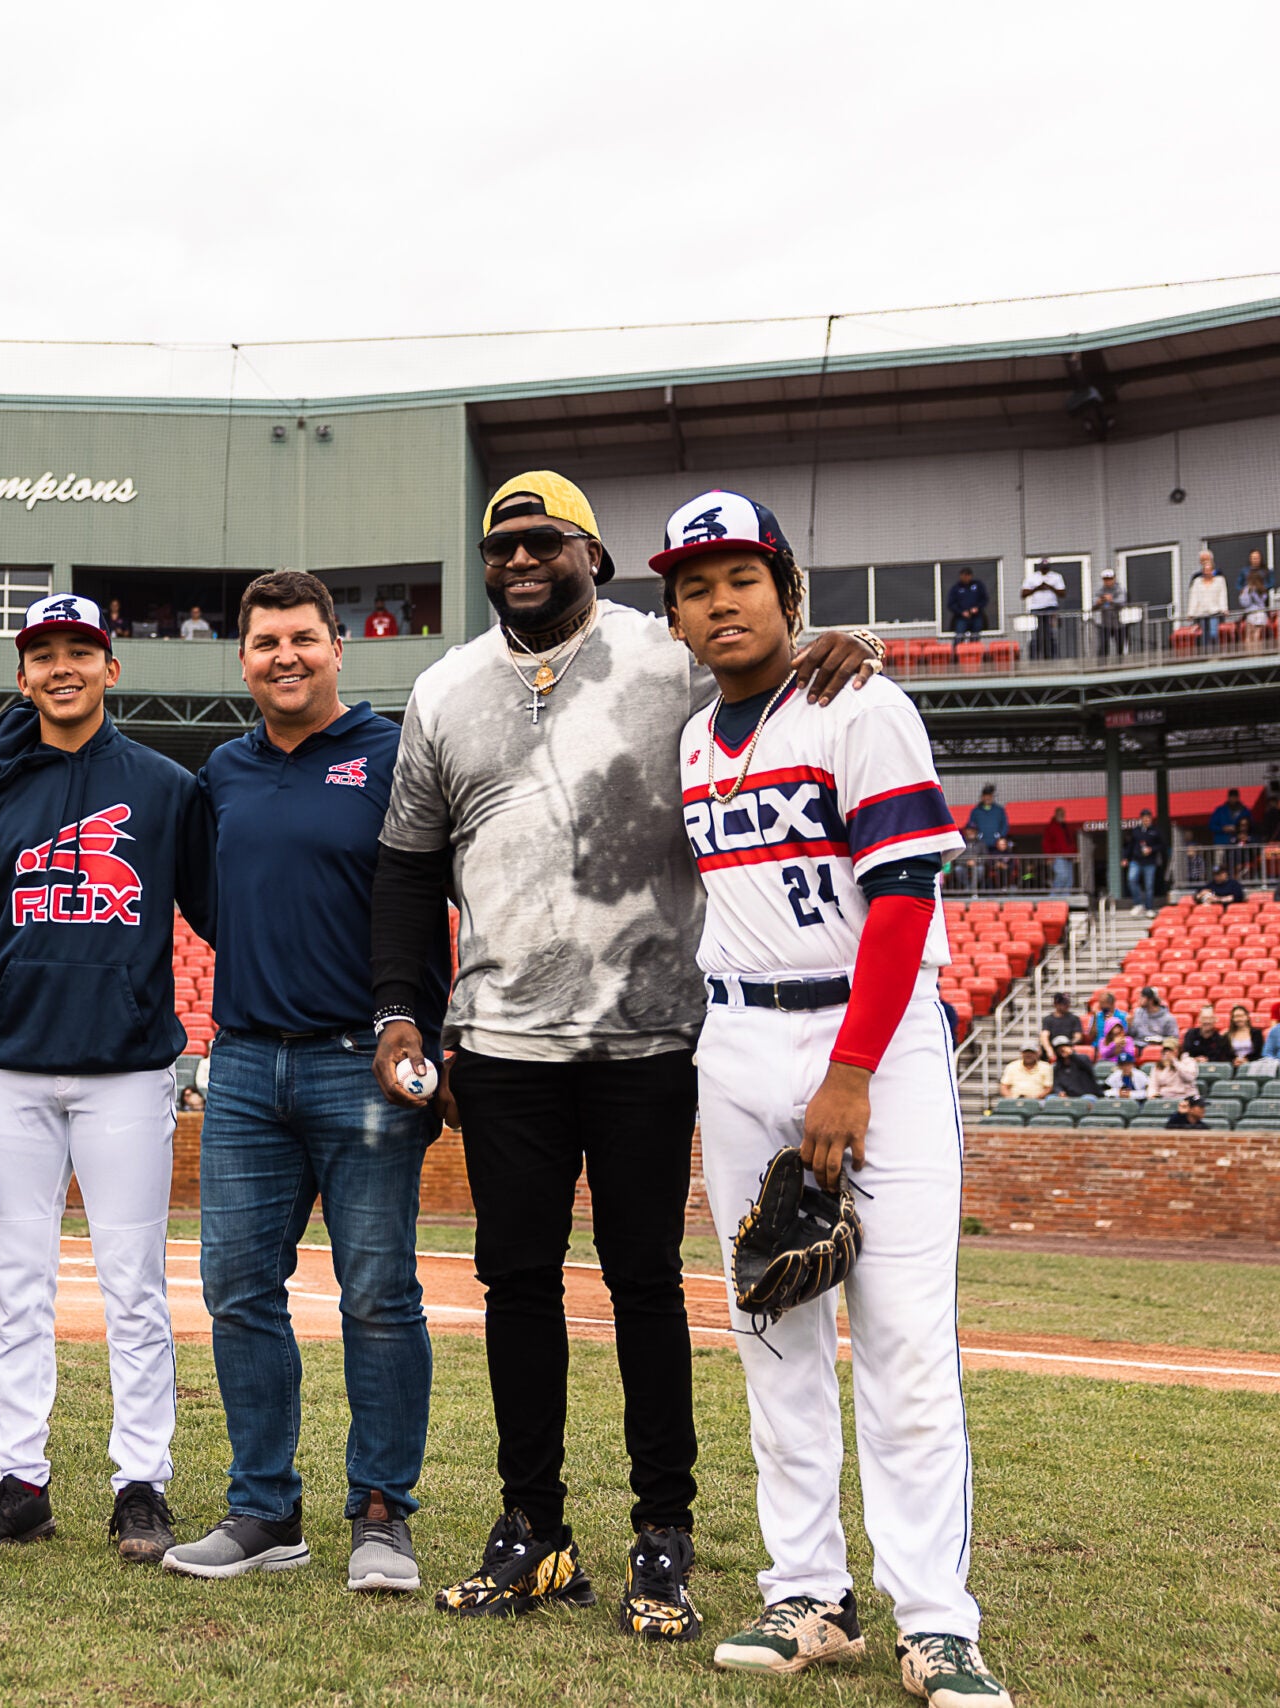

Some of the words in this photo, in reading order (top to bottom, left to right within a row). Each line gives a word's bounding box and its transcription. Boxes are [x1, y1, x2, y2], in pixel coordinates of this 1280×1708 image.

[325, 774, 366, 787] ROX
[683, 783, 827, 858] ROX
[12, 885, 141, 926] ROX
